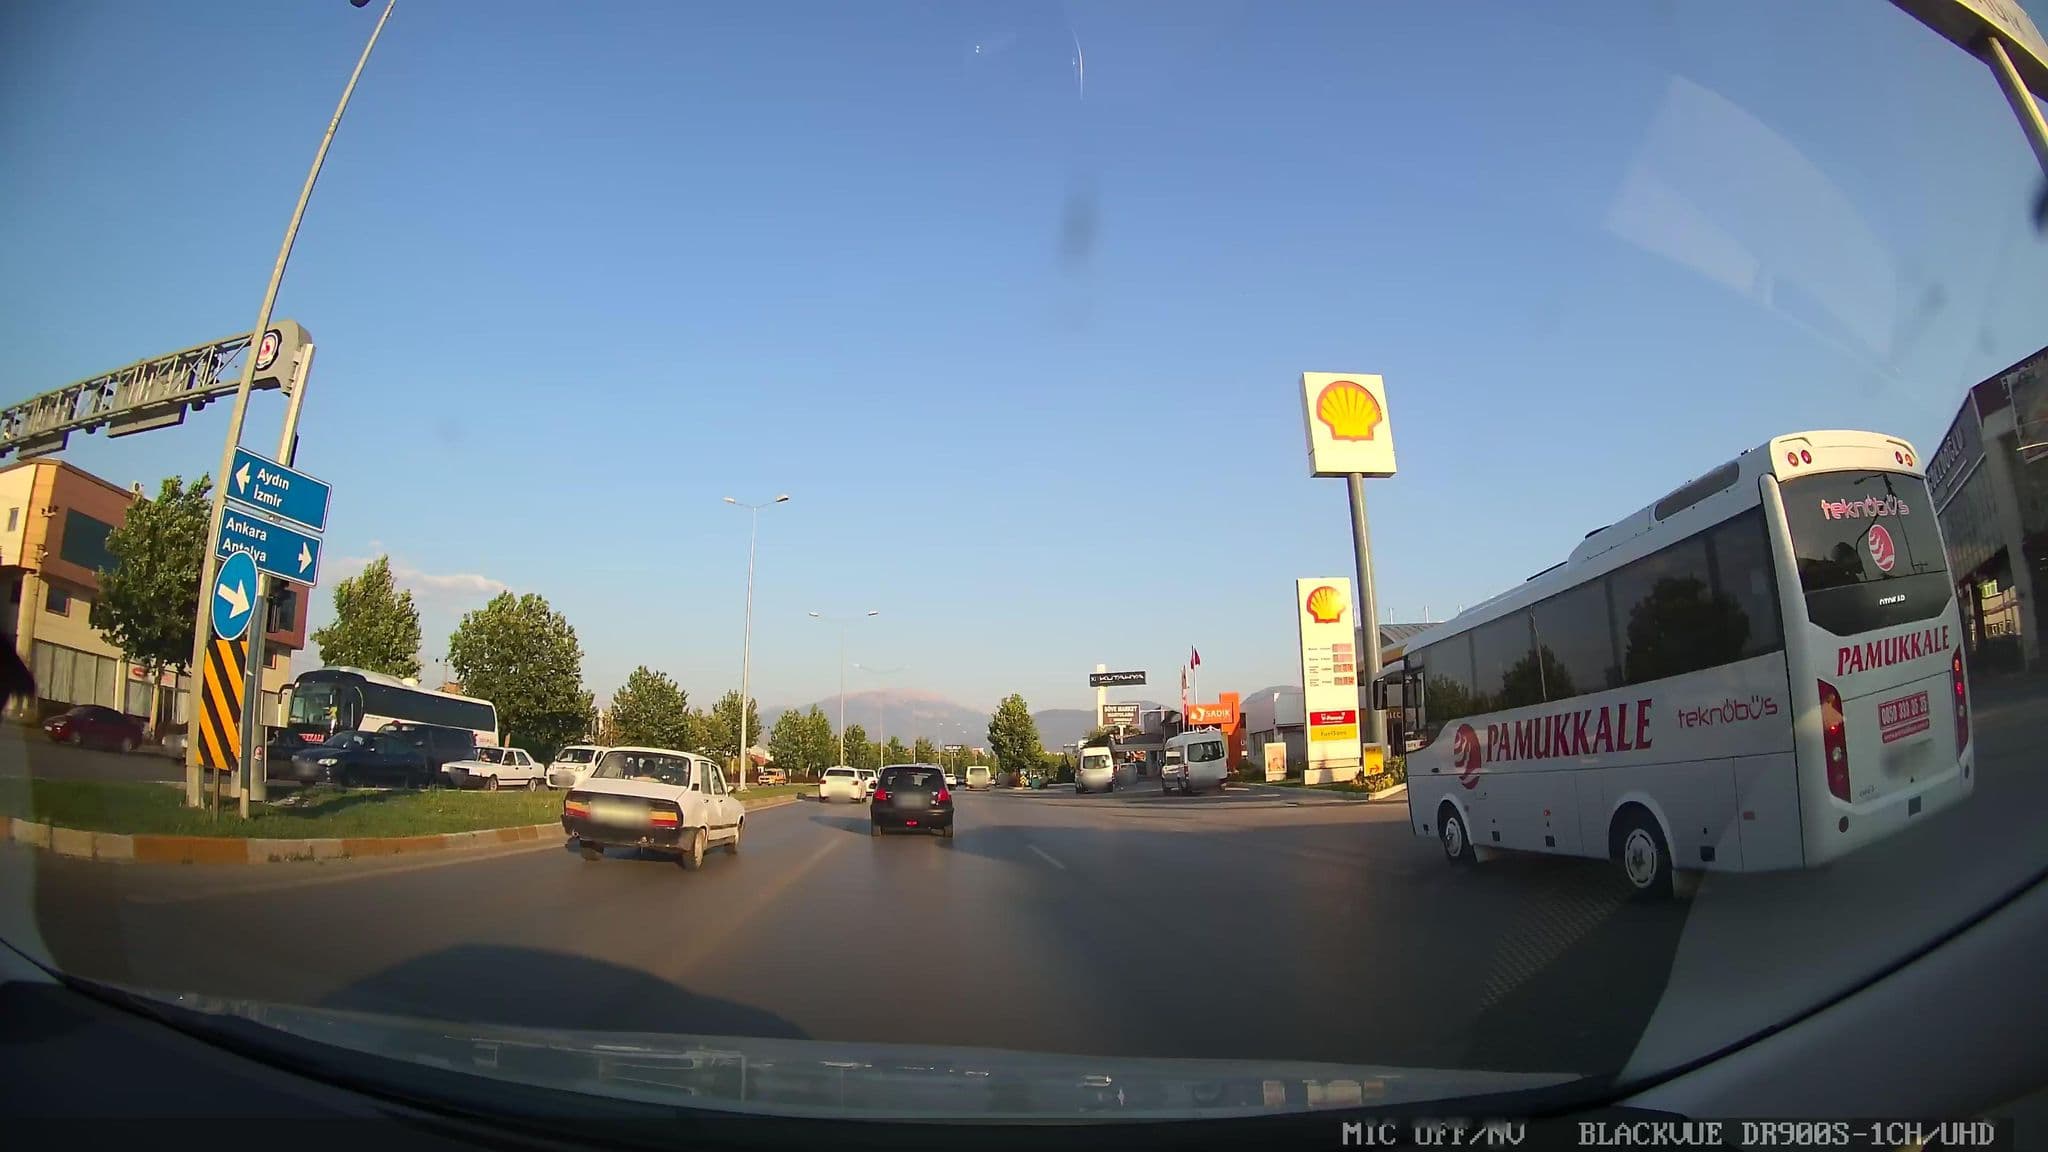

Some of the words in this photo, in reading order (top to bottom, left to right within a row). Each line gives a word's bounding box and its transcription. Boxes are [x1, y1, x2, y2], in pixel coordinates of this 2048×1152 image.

[257, 468, 290, 491] Aydın
[253, 484, 283, 508] İzmir
[225, 517, 267, 542] Ankara
[1837, 625, 1950, 677] PAMUKKALE
[1486, 698, 1653, 763] PAMUKKALE
